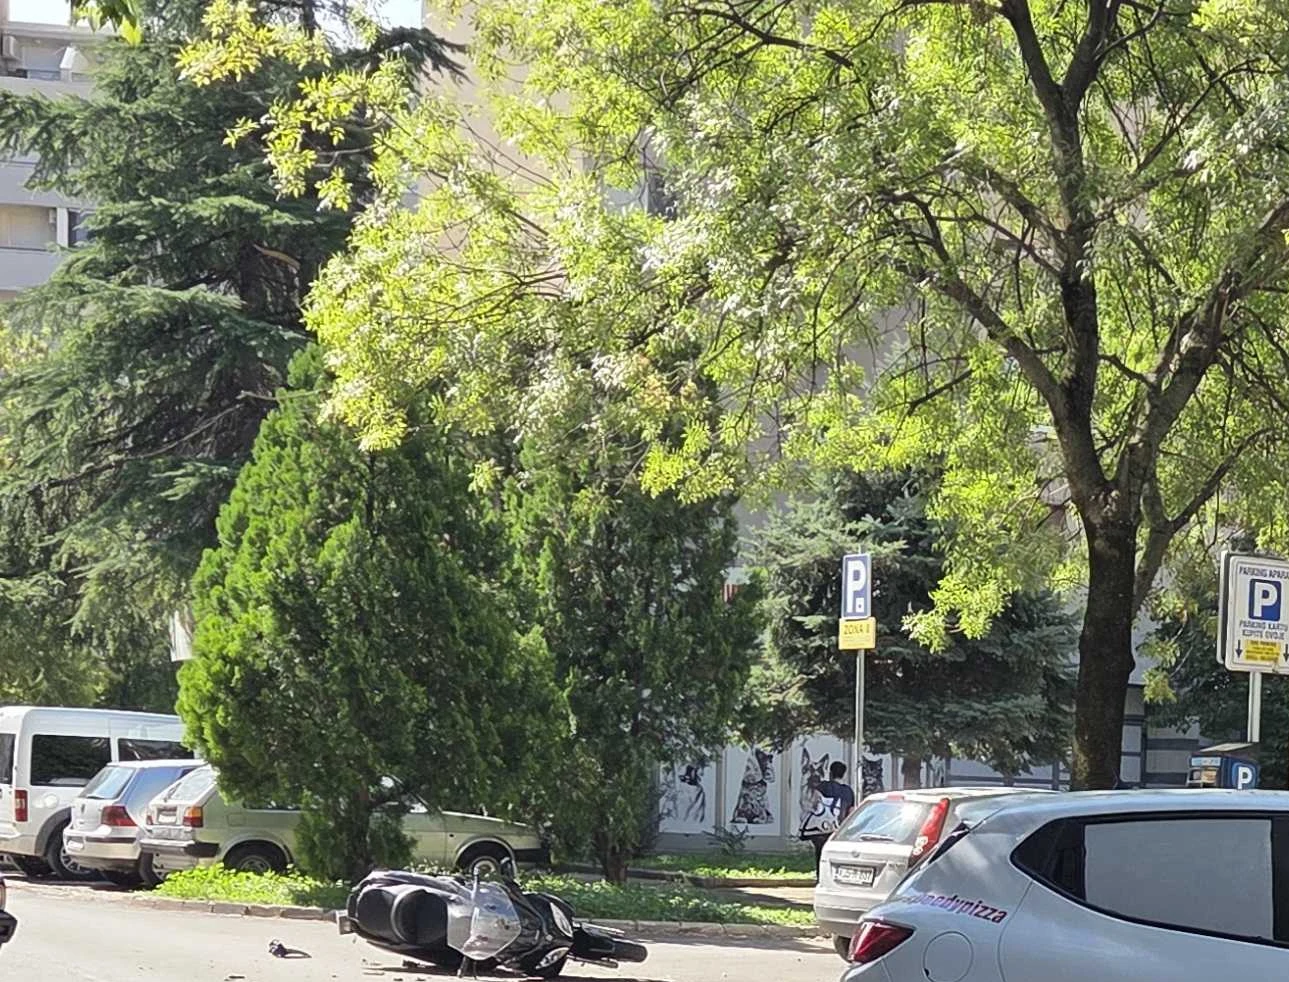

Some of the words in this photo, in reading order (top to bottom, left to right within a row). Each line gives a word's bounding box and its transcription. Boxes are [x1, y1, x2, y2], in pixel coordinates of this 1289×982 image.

[846, 560, 867, 613] P
[1253, 581, 1278, 617] P
[1237, 766, 1253, 789] P
